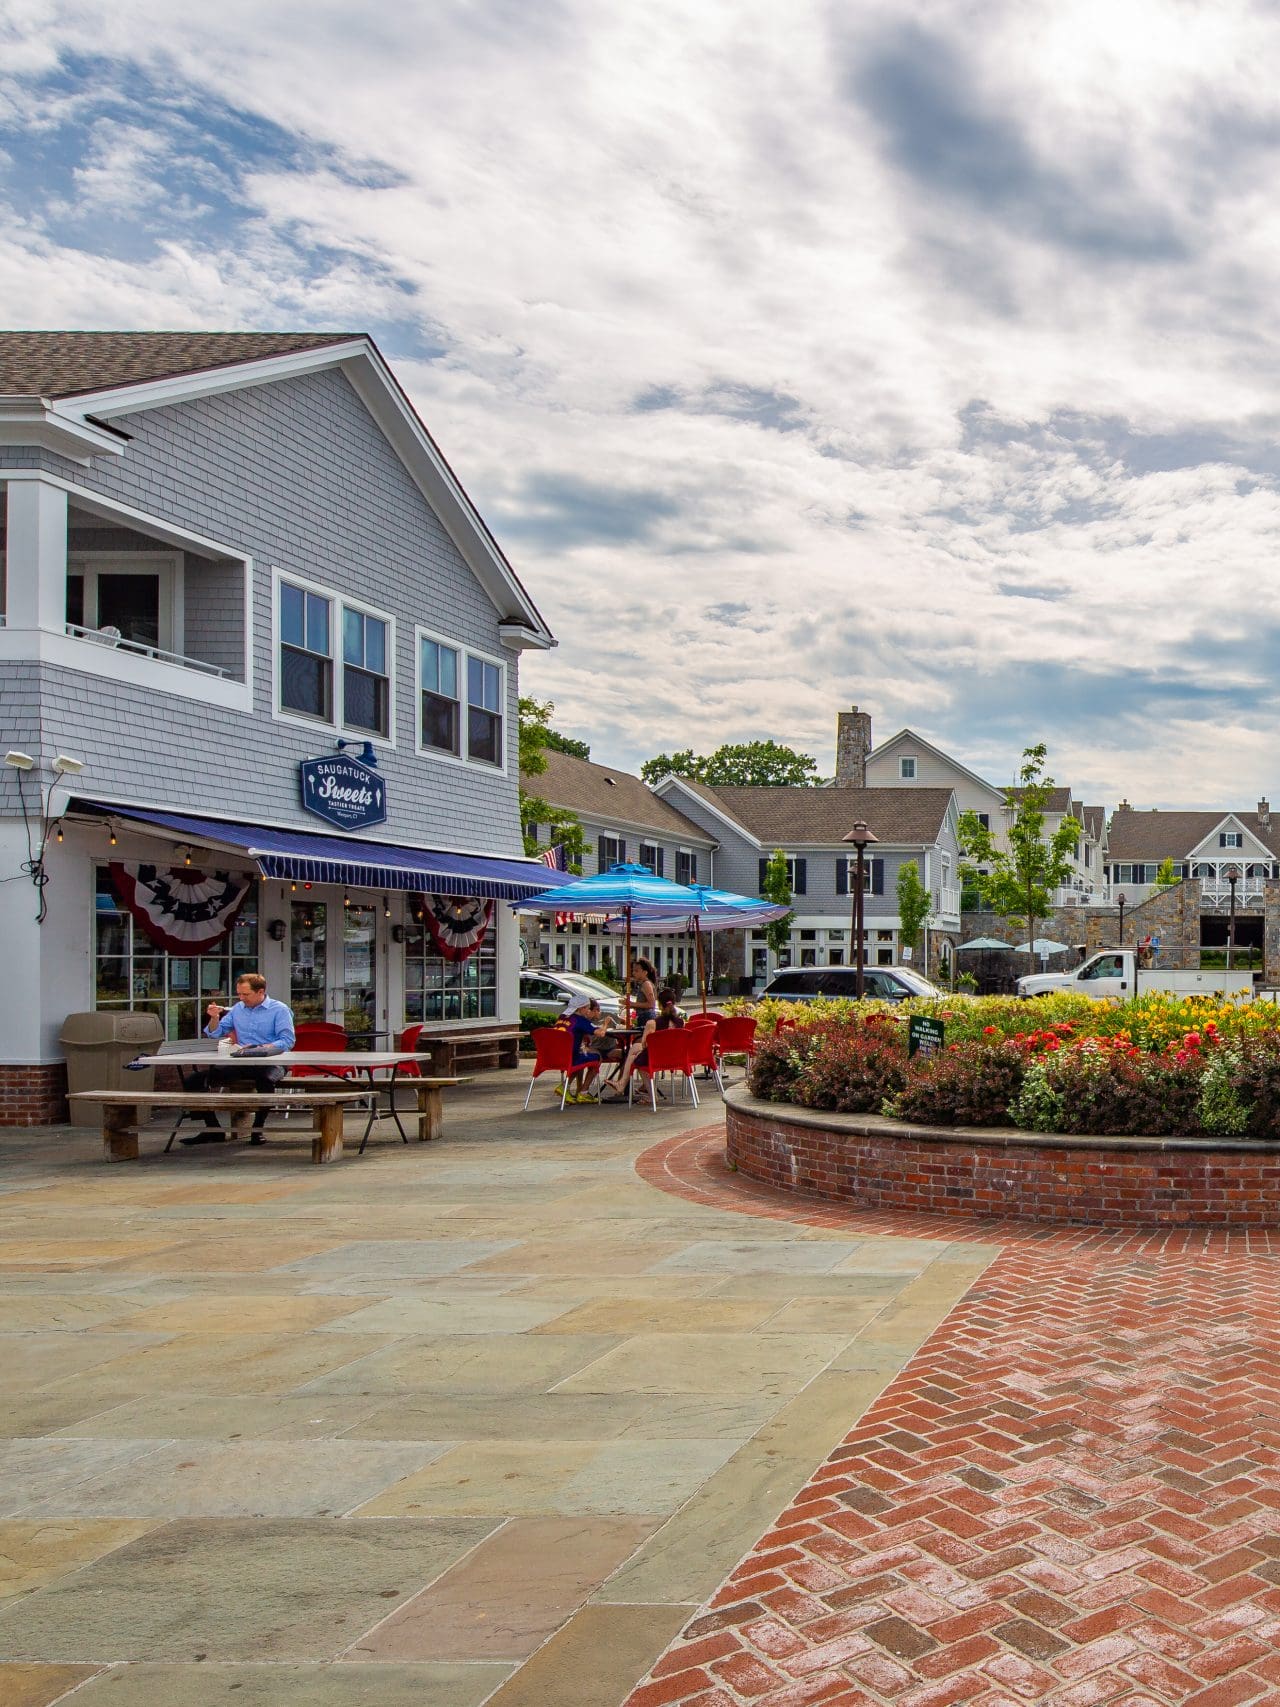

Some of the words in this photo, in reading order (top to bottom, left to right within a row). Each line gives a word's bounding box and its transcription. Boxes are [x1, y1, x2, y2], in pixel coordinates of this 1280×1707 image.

[317, 764, 370, 784] SAUGATUCK
[319, 776, 372, 805] Sweets
[328, 800, 347, 808] TASTIER
[348, 804, 365, 812] TREATS
[914, 1025, 939, 1035] WALKING
[920, 1033, 942, 1042] GARDEN
